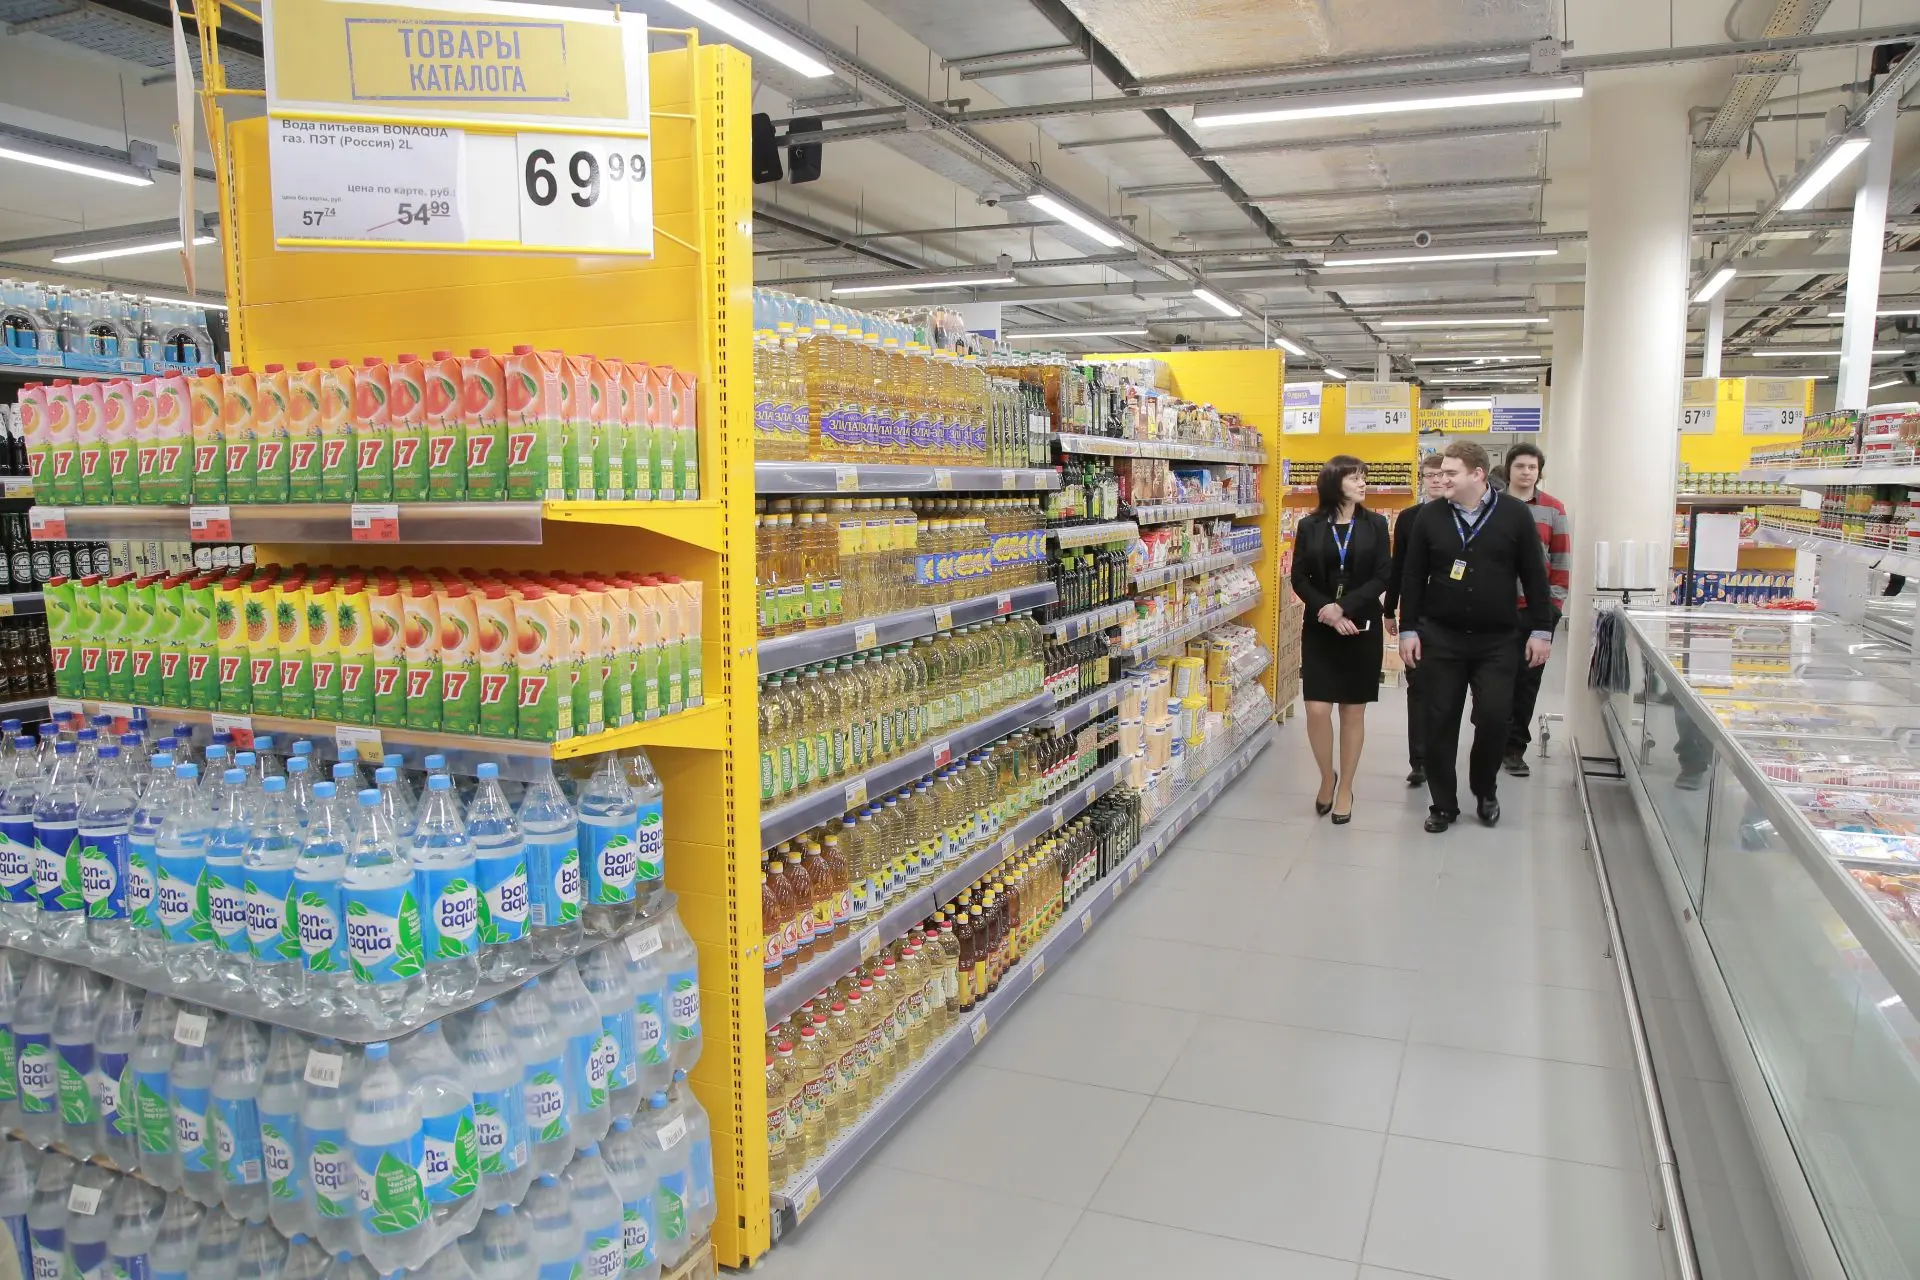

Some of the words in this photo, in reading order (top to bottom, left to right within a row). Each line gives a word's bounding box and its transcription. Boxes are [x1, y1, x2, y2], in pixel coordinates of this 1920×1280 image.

[397, 28, 521, 59] ТОВАРЫ
[409, 63, 527, 93] КАТАЛОГА
[282, 119, 316, 131] Вода
[319, 123, 379, 134] питьевая
[383, 125, 448, 138] BONAQUA
[282, 135, 305, 144] газ.
[310, 135, 336, 145] ПЭТ
[340, 136, 395, 150] (Россия)
[399, 139, 413, 150] 2L
[347, 184, 374, 195] цена
[378, 186, 391, 194] по
[525, 148, 601, 208] 69
[608, 152, 647, 182] 99
[303, 211, 324, 226] 57
[398, 203, 430, 226] 54
[1302, 412, 1313, 424] 54
[1385, 411, 1399, 424] 54
[1684, 410, 1701, 424] 57
[1781, 410, 1794, 424] 39
[53, 450, 74, 478] J7
[80, 450, 101, 478] J7
[109, 449, 129, 477] J7
[138, 448, 159, 477] J7
[159, 446, 182, 475] J7
[195, 445, 218, 475] J7
[227, 444, 250, 474] J7
[257, 442, 283, 473] J7
[290, 441, 317, 472] J7
[322, 440, 347, 471] J7
[358, 438, 384, 472] J7
[393, 437, 421, 470] J7
[429, 435, 456, 469] J7
[467, 434, 495, 469] J7
[508, 432, 537, 468] J7
[81, 648, 102, 674] J7
[107, 649, 128, 675] J7
[133, 651, 153, 678] J7
[161, 653, 181, 680] J7
[188, 655, 209, 682] J7
[219, 657, 242, 685] J7
[251, 659, 274, 687] J7
[280, 660, 303, 689] J7
[312, 663, 335, 691] J7
[341, 664, 364, 694] J7
[375, 666, 400, 697] J7
[407, 669, 434, 699] J7
[443, 671, 470, 702] J7
[481, 674, 509, 706] J7
[519, 676, 548, 708] J7
[562, 879, 579, 894] aq
[246, 901, 265, 915] on
[246, 915, 277, 930] qua
[348, 918, 377, 937] bon
